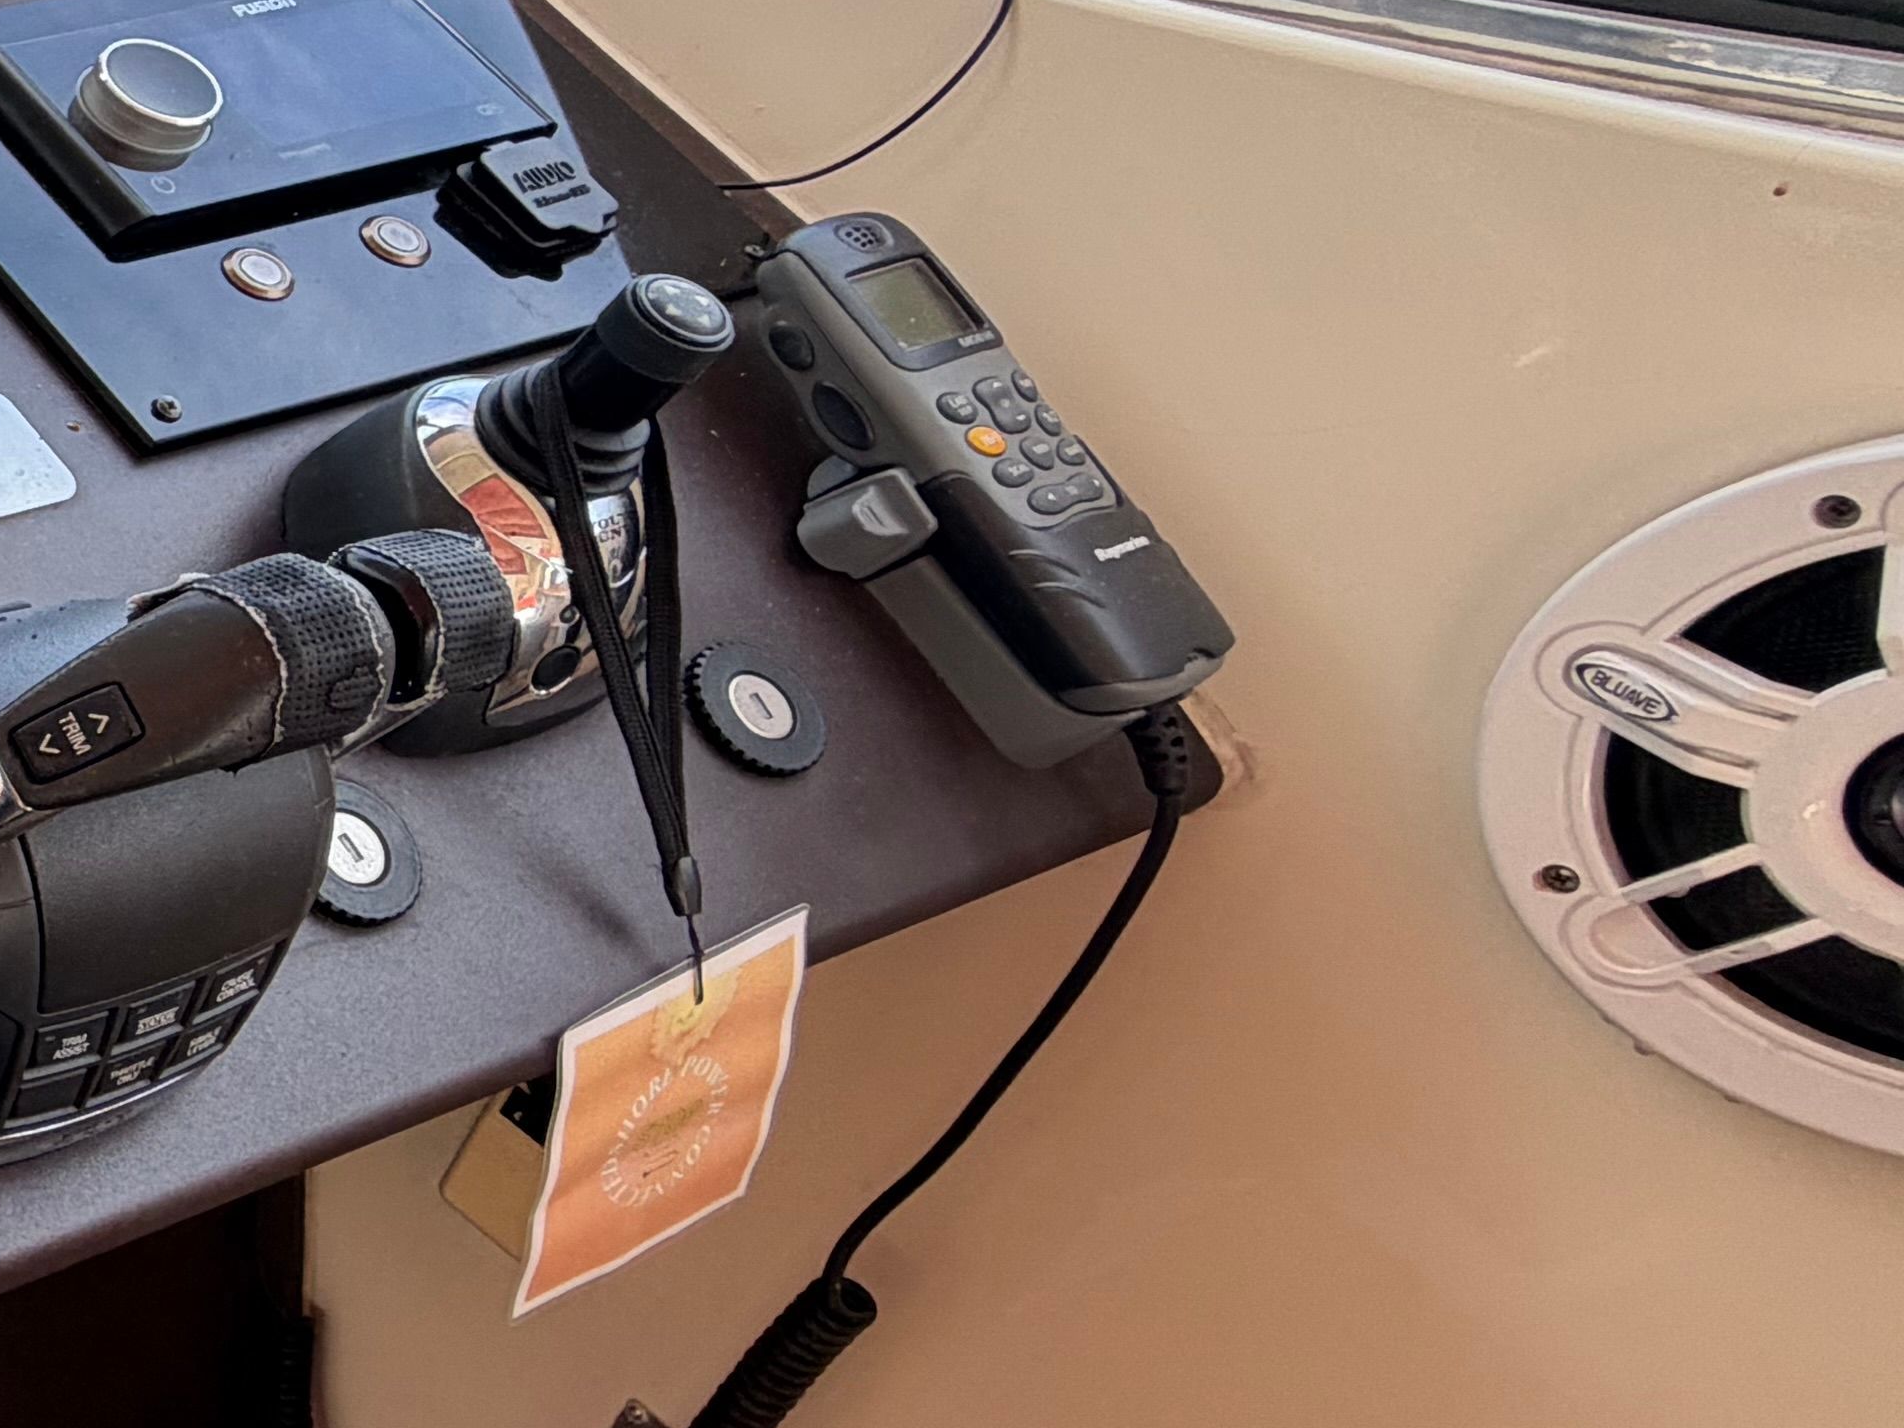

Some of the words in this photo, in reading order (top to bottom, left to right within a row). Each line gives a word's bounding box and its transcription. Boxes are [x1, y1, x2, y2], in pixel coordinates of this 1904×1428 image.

[513, 162, 577, 195] AUDIO
[1591, 669, 1662, 714] BLUAVE
[58, 711, 92, 756] TRIM
